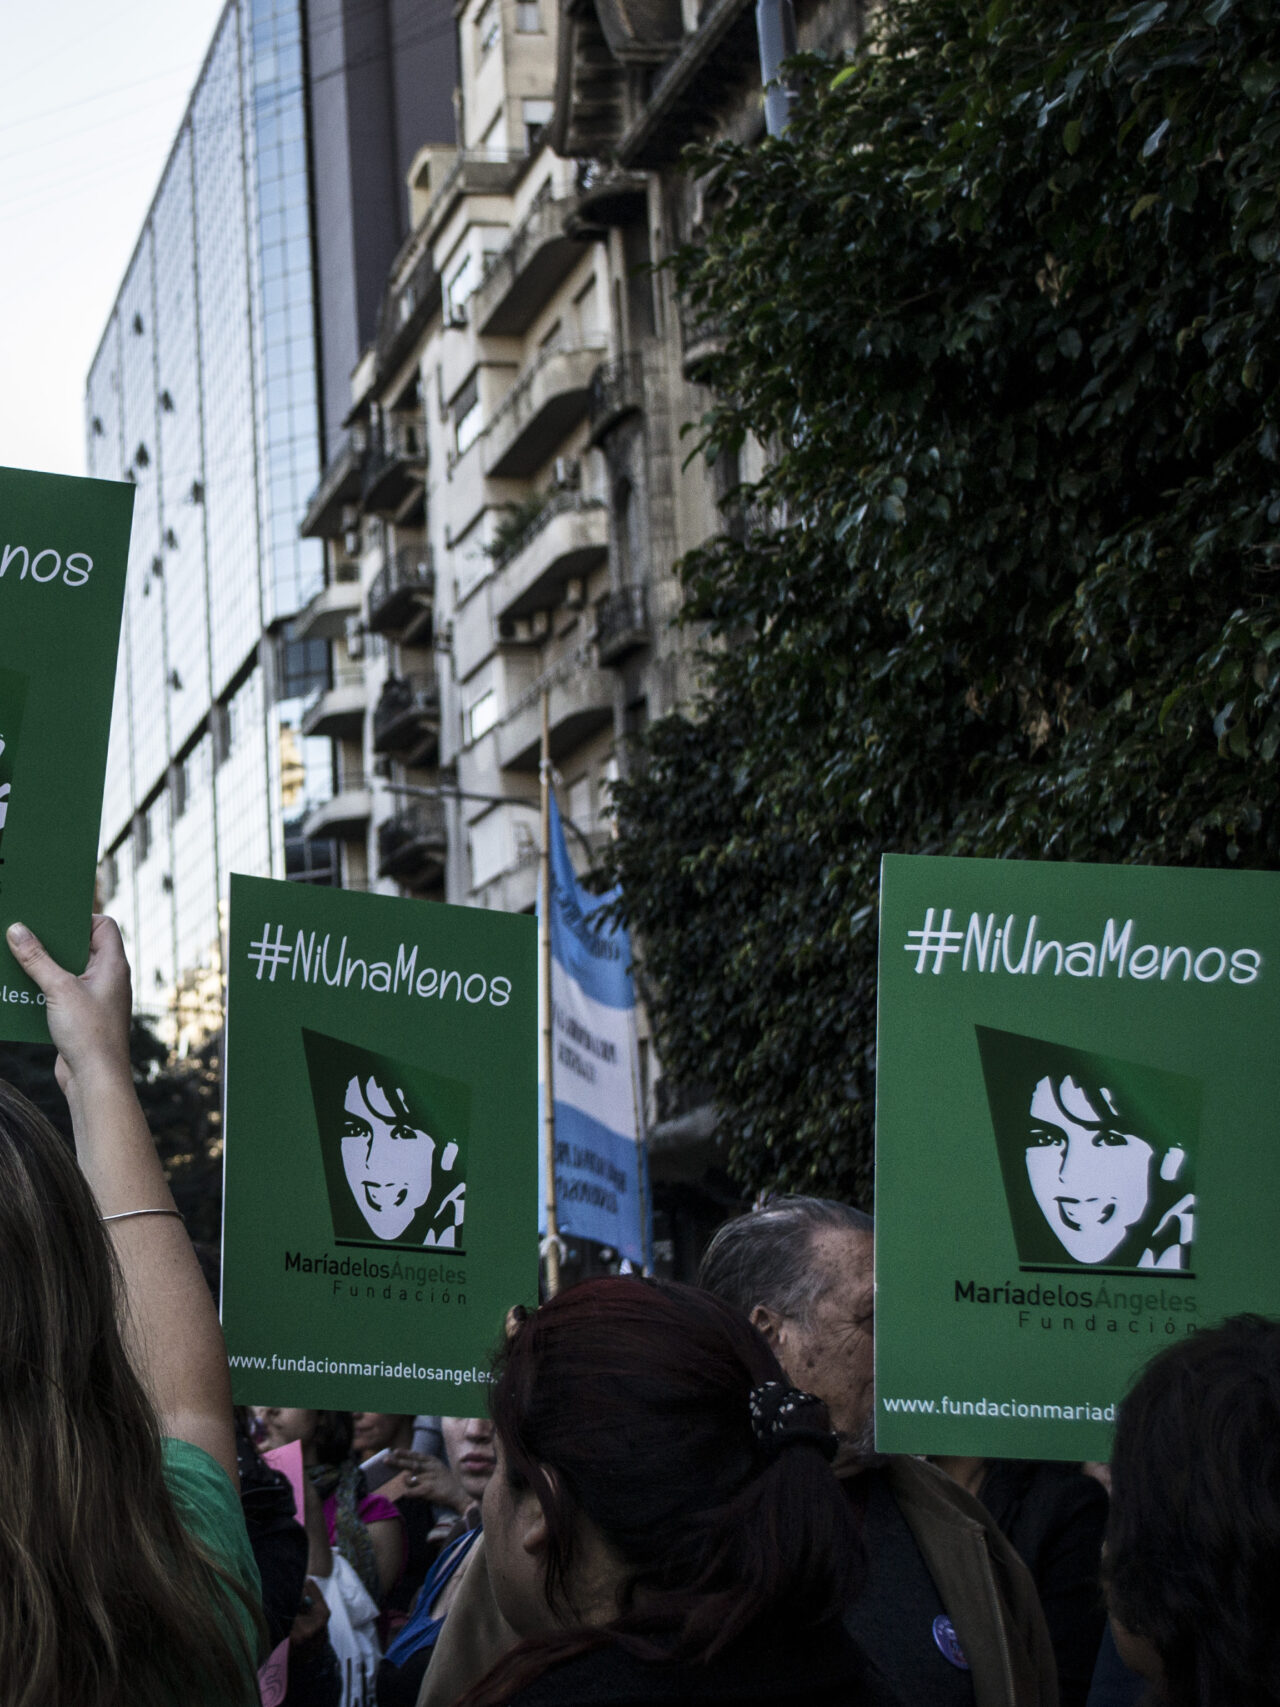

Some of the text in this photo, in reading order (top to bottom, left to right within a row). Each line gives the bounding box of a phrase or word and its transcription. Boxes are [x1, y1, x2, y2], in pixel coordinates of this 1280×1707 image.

[904, 907, 1261, 984] #NiUnaMenos
[247, 922, 512, 1006] #NiUnaMenos
[333, 1280, 467, 1305] Fundación
[227, 1354, 499, 1386] www.fundacionmariadelosangeles.
[883, 1396, 1116, 1422] www.fundacionmariad
